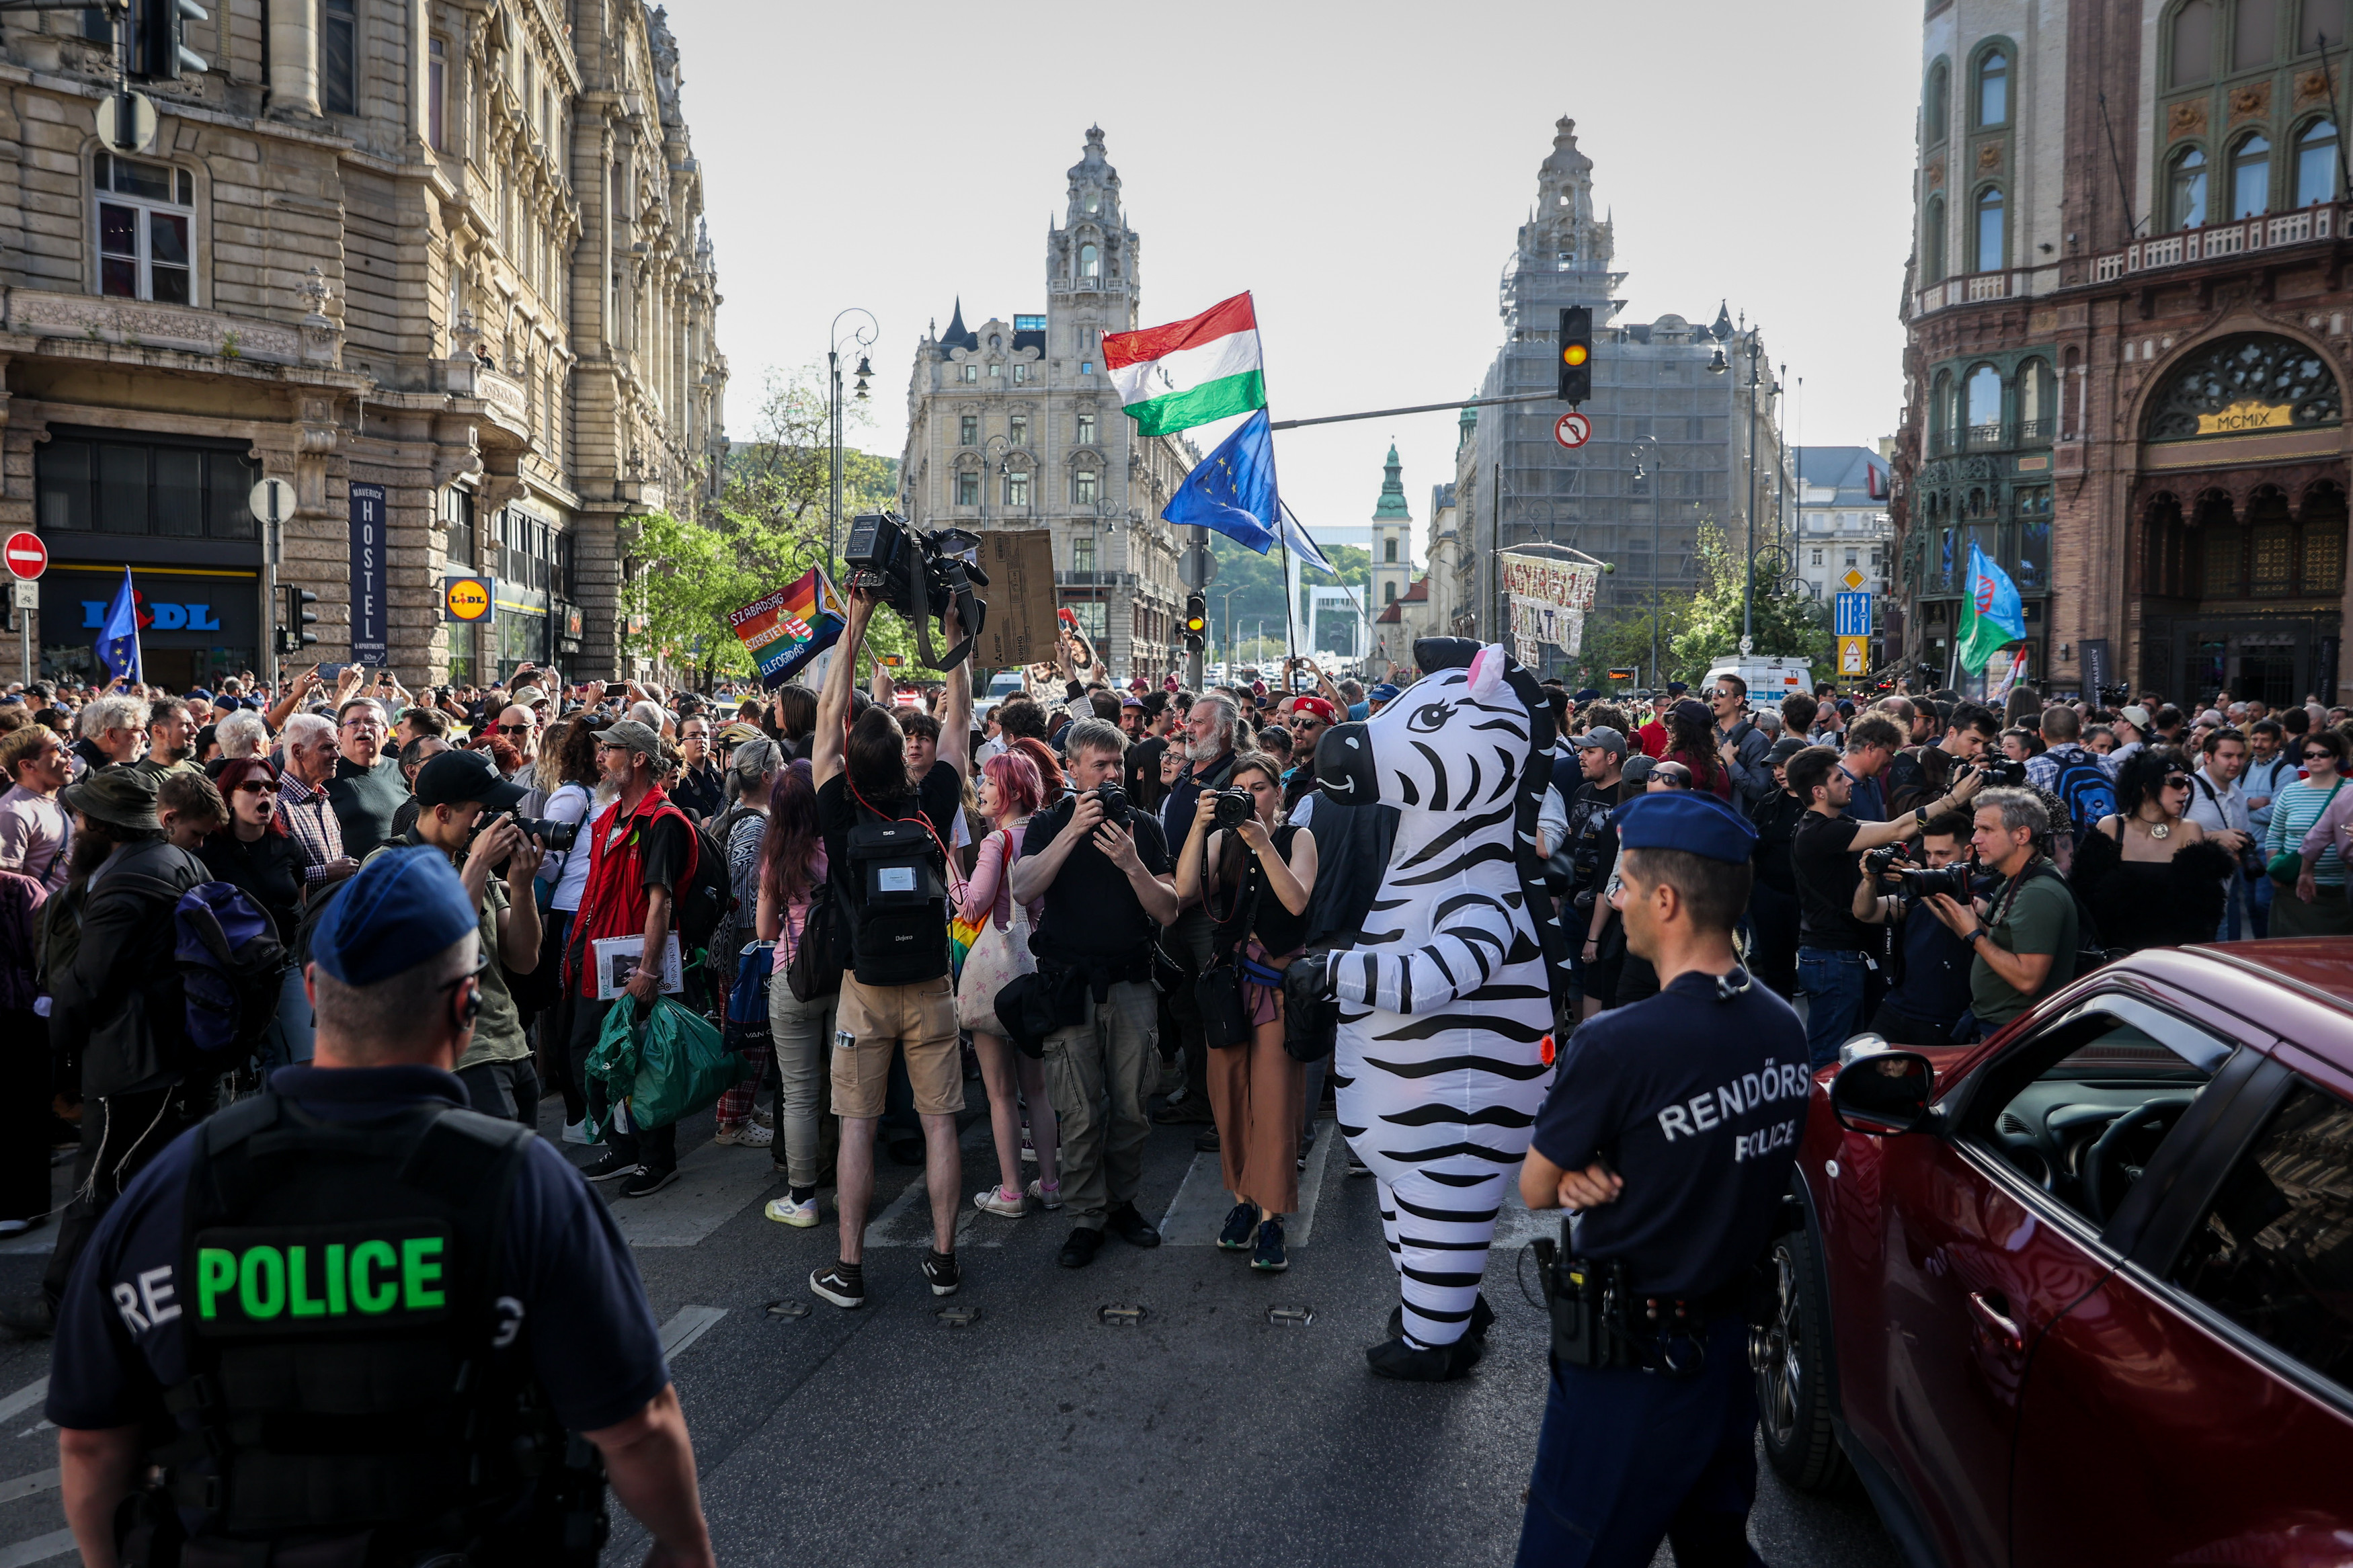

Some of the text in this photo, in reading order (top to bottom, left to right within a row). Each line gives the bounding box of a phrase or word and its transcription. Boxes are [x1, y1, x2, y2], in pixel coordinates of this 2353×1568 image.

[2217, 411, 2270, 430] MCMIX
[353, 487, 383, 500] MAVERICK
[363, 500, 374, 638] HOSTEL
[730, 592, 785, 626] SZABADSÁG
[745, 624, 785, 651] SZERETET
[760, 643, 805, 676] ELFOGADÁS
[1657, 1057, 1811, 1142] RENDŐRS
[1735, 1119, 1795, 1163] POLICE
[198, 1237, 445, 1320] POLICE
